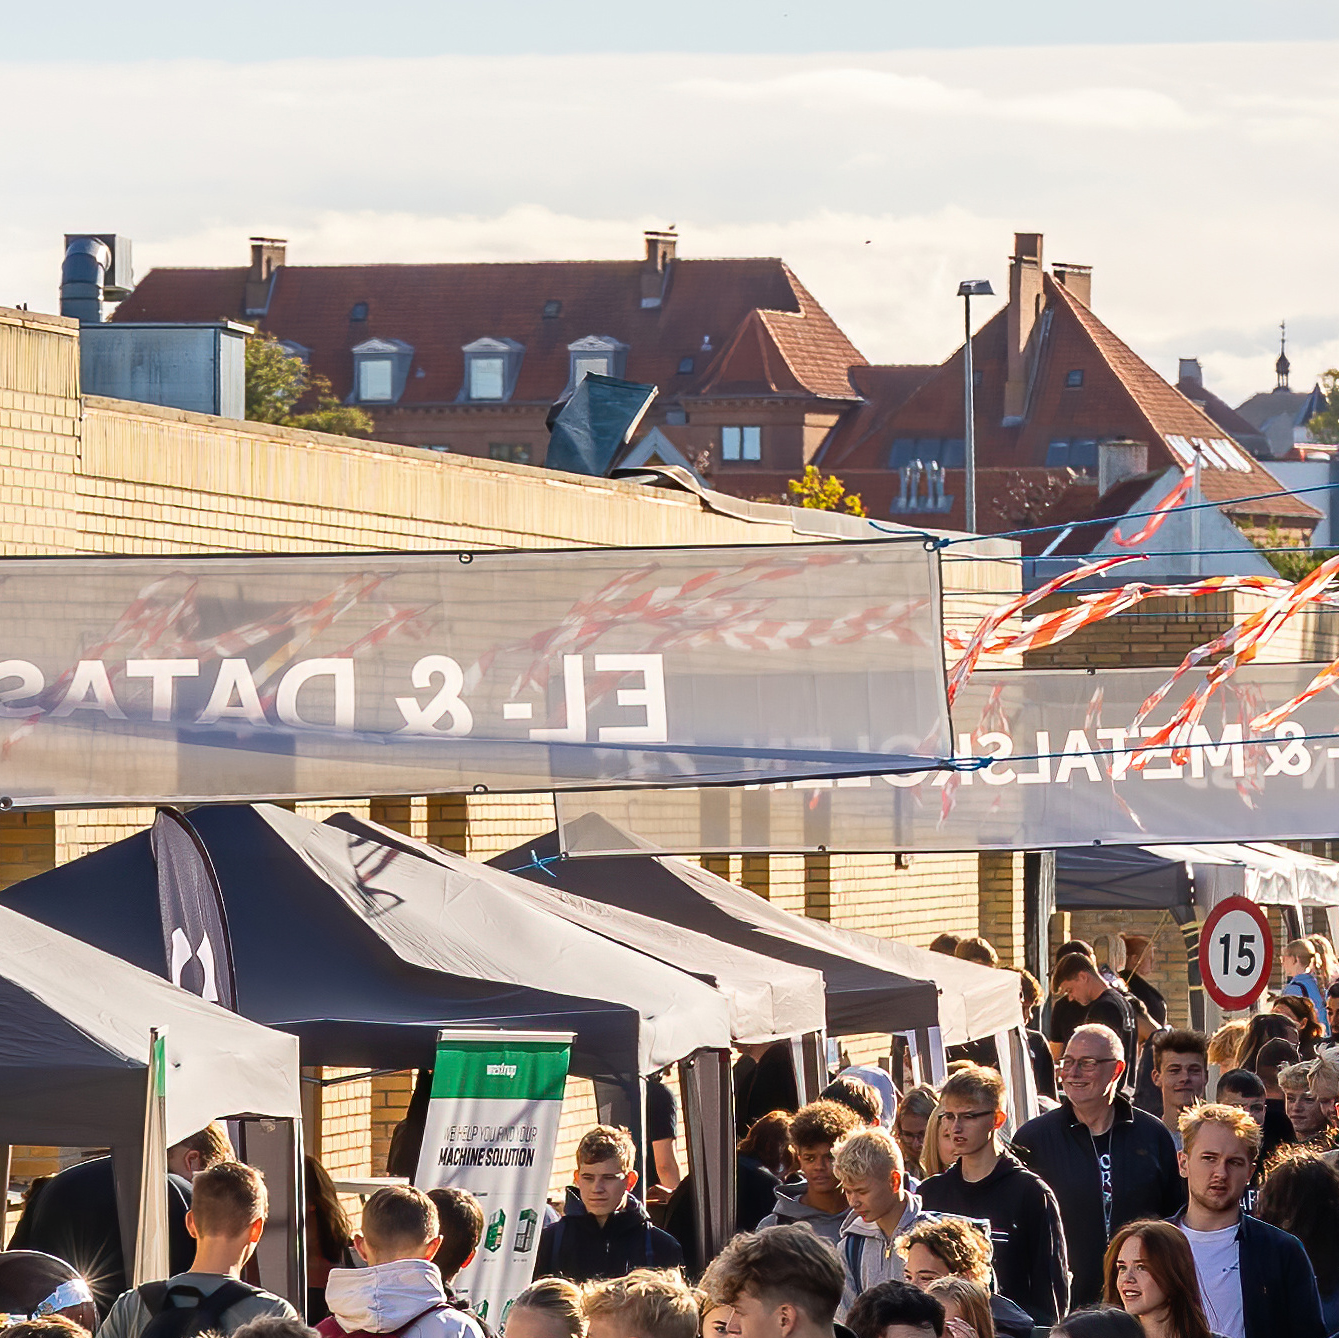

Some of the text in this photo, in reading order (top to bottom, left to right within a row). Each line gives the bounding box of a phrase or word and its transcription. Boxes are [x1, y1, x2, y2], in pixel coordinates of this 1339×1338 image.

[1219, 933, 1256, 977] 15
[437, 1146, 536, 1167] MACHINE SOLUTION
